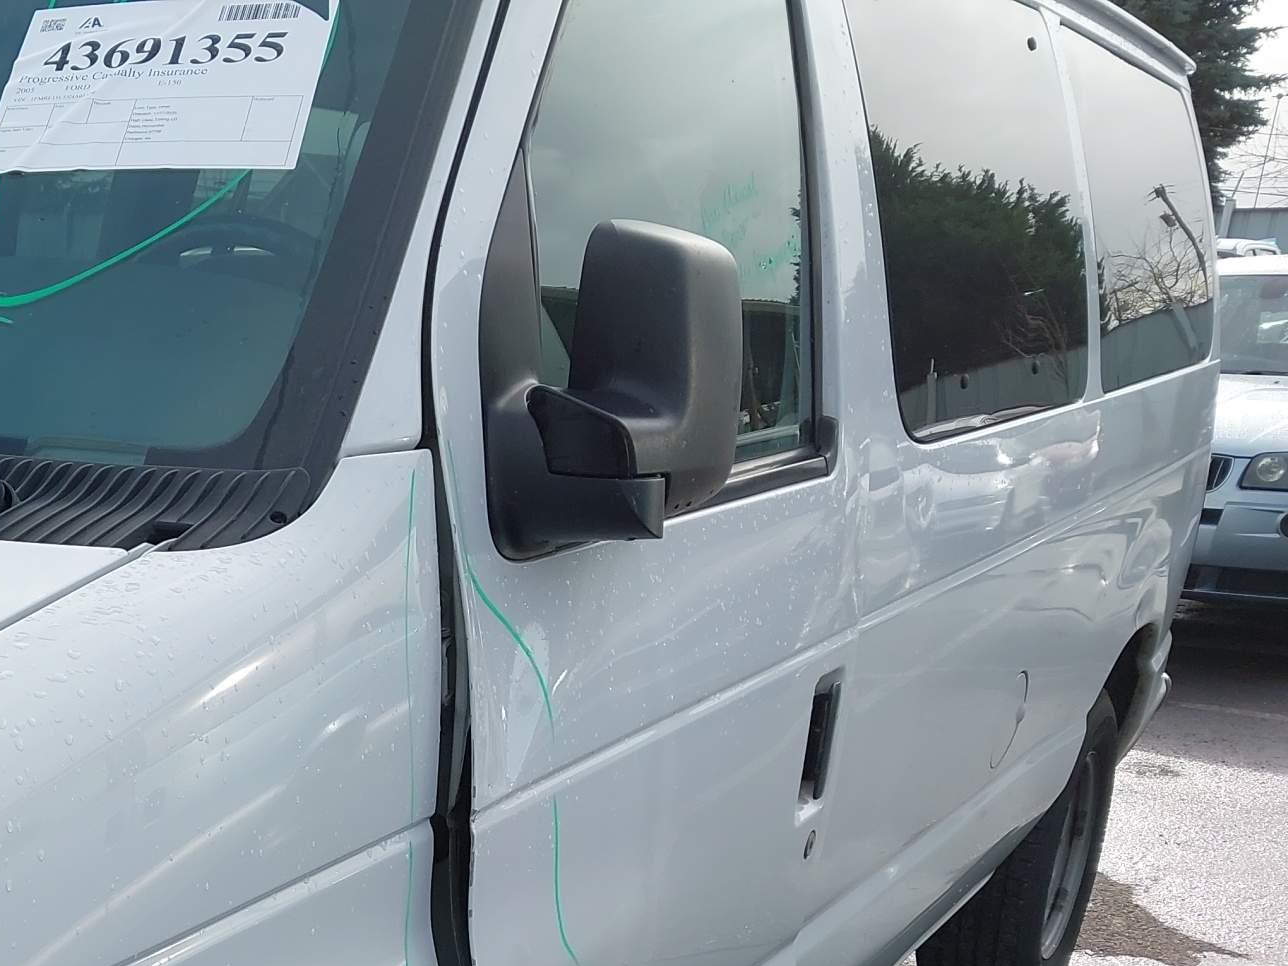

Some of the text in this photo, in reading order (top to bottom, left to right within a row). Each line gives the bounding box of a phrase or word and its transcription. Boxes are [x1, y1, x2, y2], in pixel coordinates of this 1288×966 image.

[43, 31, 289, 72] 43691355
[19, 73, 88, 86] Progressive
[148, 68, 208, 77] Insurance
